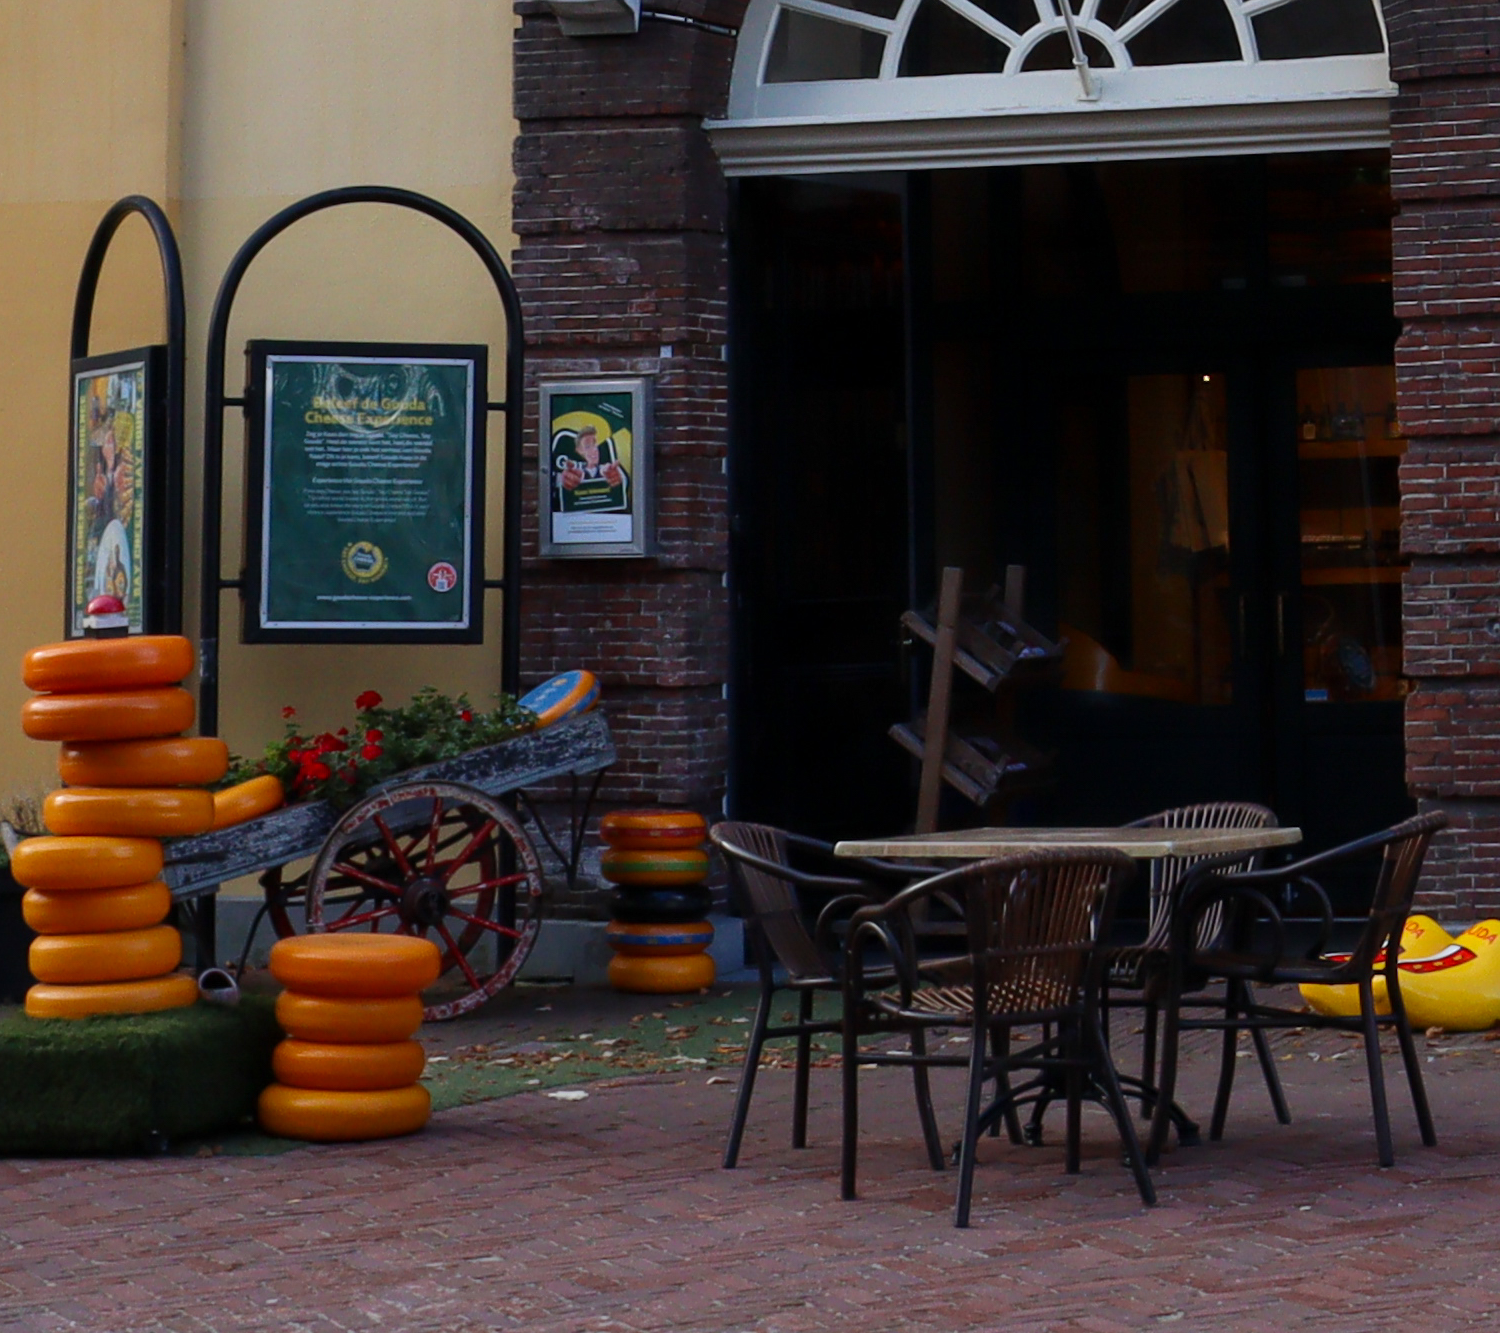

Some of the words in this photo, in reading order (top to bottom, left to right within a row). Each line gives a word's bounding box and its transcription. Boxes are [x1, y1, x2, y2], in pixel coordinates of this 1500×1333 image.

[361, 397, 378, 410] de
[381, 397, 426, 411] Gouda
[305, 411, 354, 425] Cheese
[357, 412, 434, 428] Experience
